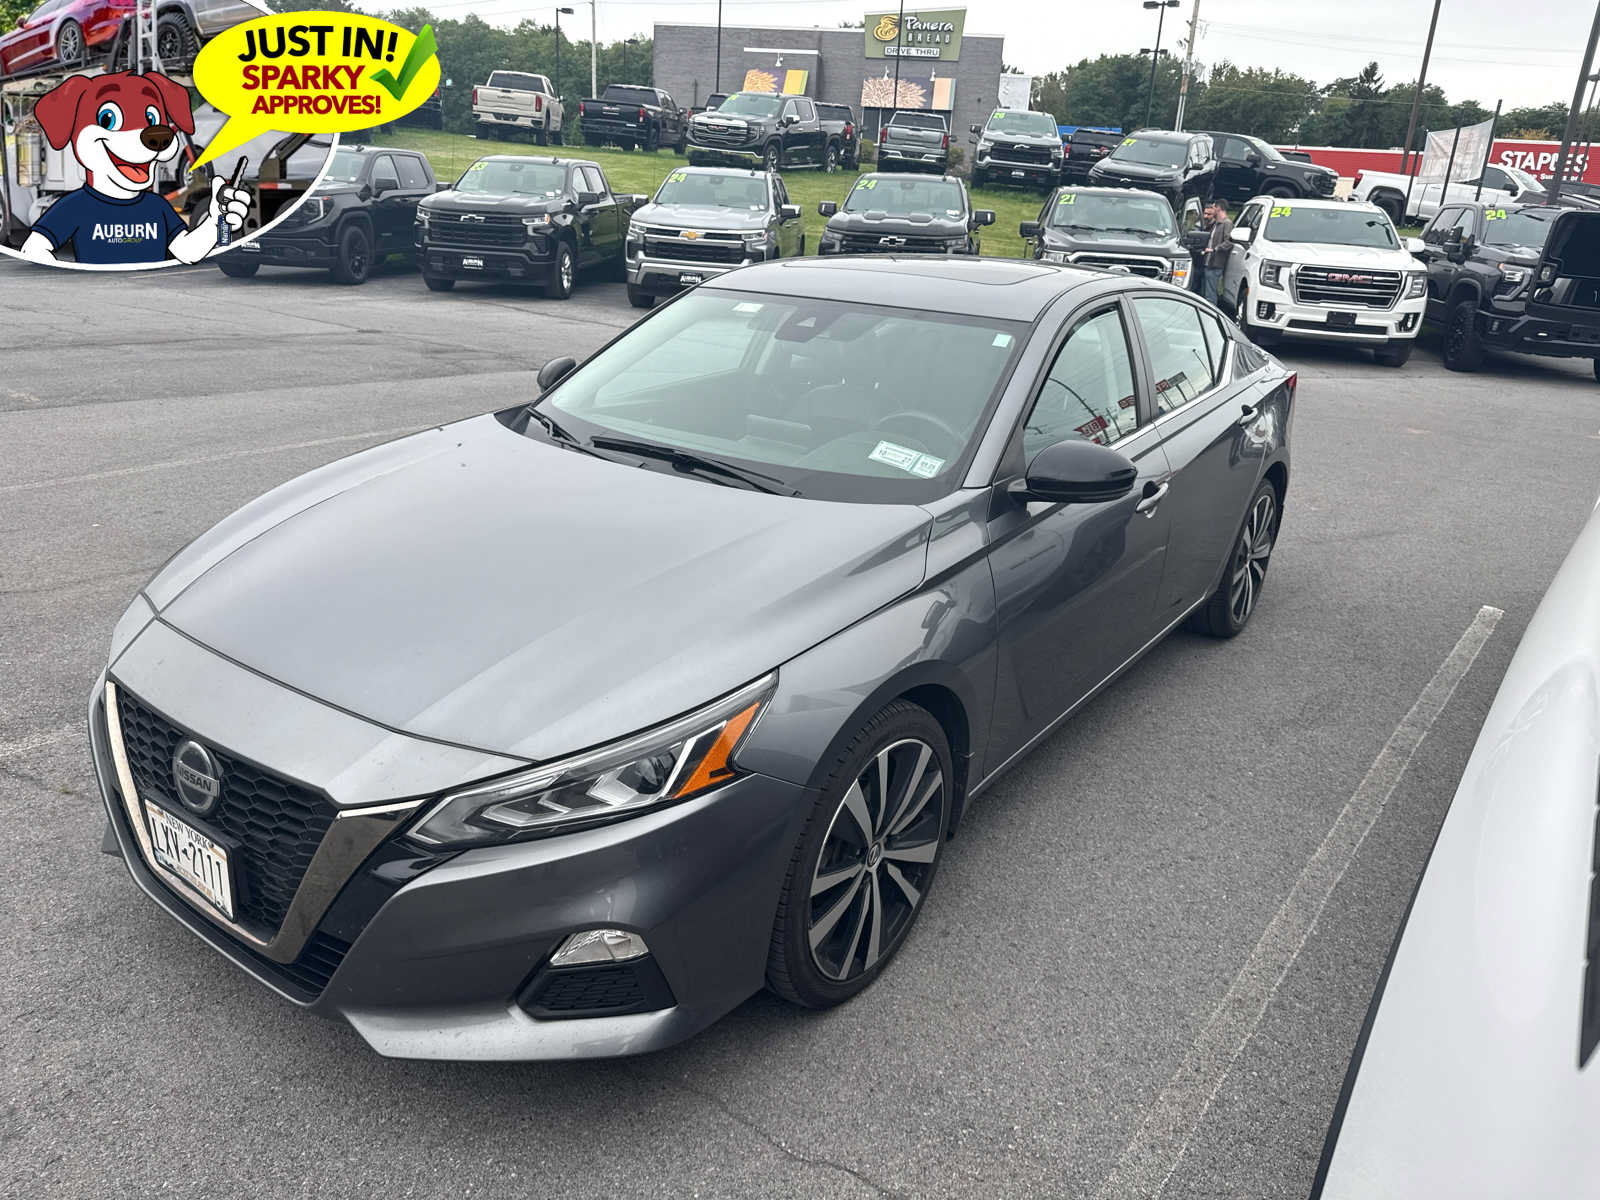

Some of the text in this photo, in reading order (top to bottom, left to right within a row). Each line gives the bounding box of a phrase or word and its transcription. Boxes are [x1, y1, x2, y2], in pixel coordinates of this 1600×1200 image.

[904, 16, 954, 32] Panera
[907, 32, 951, 44] BREAD
[886, 47, 939, 56] DRVE THRU
[669, 173, 687, 183] 24
[855, 179, 878, 190] 24
[1058, 194, 1076, 205] 21
[1271, 206, 1292, 218] 24
[1485, 209, 1507, 220] 24
[1327, 272, 1374, 285] GMC
[176, 764, 212, 792] NISSAN
[165, 813, 209, 851] NEW YORK
